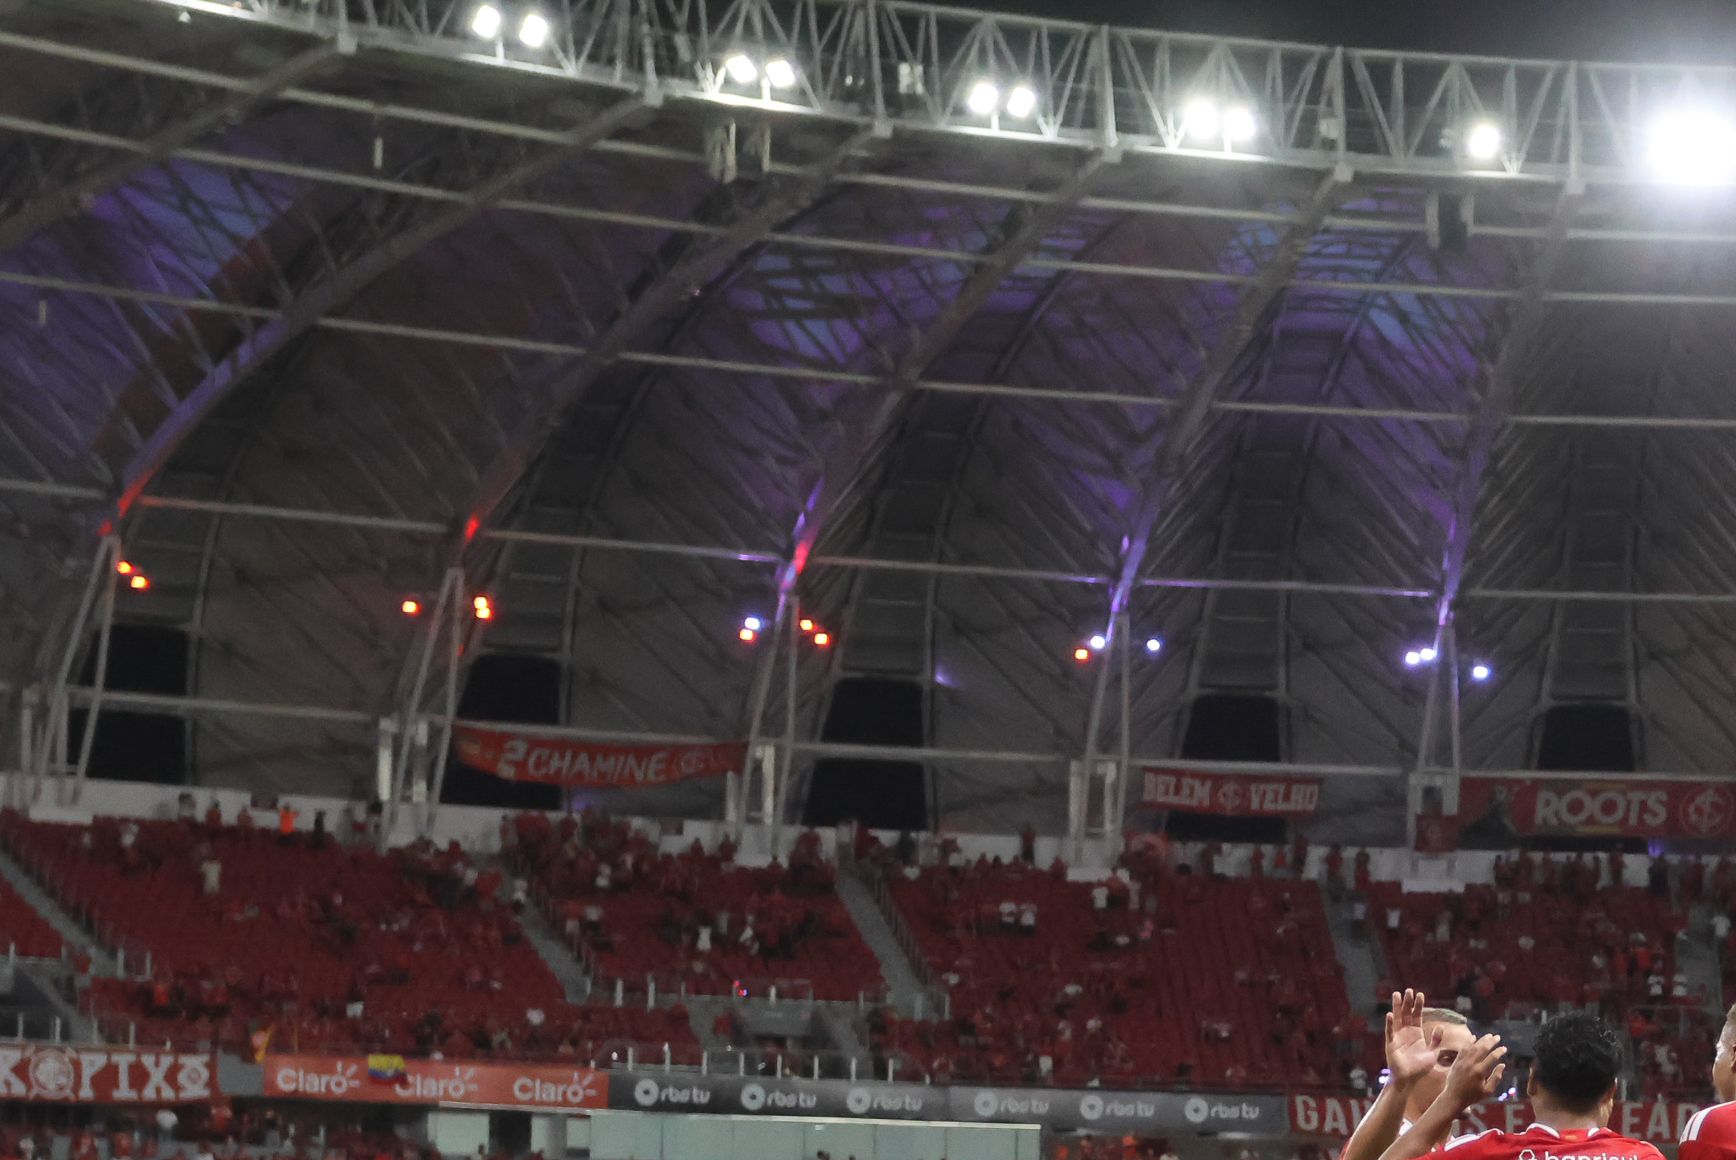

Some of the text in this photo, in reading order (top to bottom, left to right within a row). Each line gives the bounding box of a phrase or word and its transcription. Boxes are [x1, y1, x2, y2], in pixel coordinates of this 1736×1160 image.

[1251, 783, 1320, 811] VELHO
[1535, 791, 1669, 827] ROOTS
[277, 1066, 349, 1094] Claro
[514, 1076, 585, 1103] Claro
